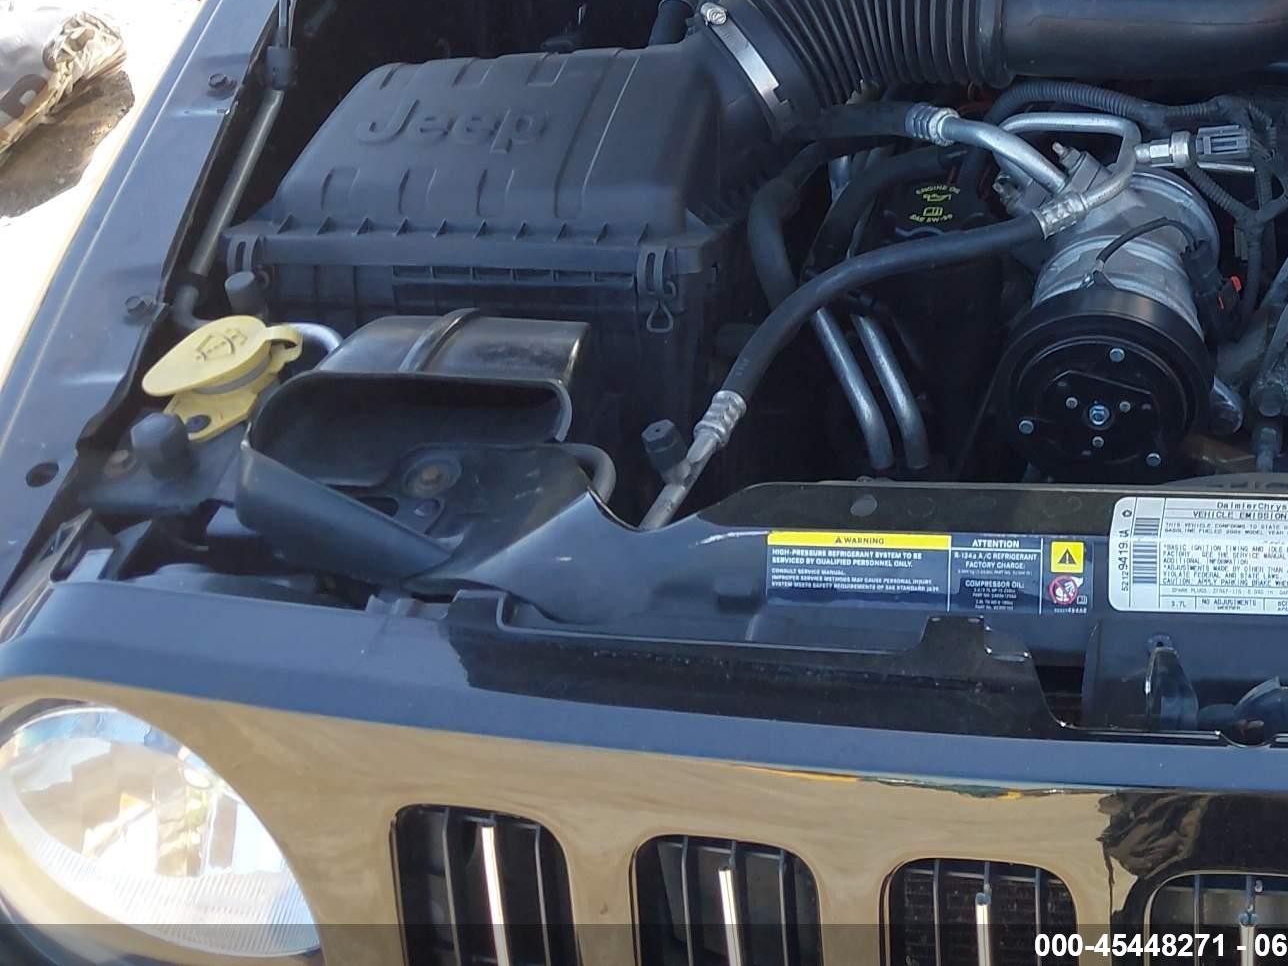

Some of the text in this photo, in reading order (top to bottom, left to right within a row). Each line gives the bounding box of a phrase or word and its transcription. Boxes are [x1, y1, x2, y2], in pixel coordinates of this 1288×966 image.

[357, 99, 550, 154] Jeep
[915, 184, 948, 195] ENGINE
[1193, 511, 1234, 519] VEHICLE
[1239, 512, 1287, 520] EMISSION
[844, 537, 885, 545] WARNING
[972, 539, 1020, 548] ATTENTION
[772, 549, 827, 557] HIGH-PRESSURE
[828, 550, 873, 558] REFRIGERANT
[875, 551, 902, 559] SYSTEM
[978, 552, 992, 560] A/C
[993, 553, 1038, 561] REFRIGERANT
[772, 557, 805, 565] SERVICED
[815, 558, 851, 566] QUALIFIED
[853, 559, 892, 567] PERSONNEL
[965, 561, 1025, 570] FACTORY CHARGE:
[965, 580, 1010, 588] COMPRESSOR
